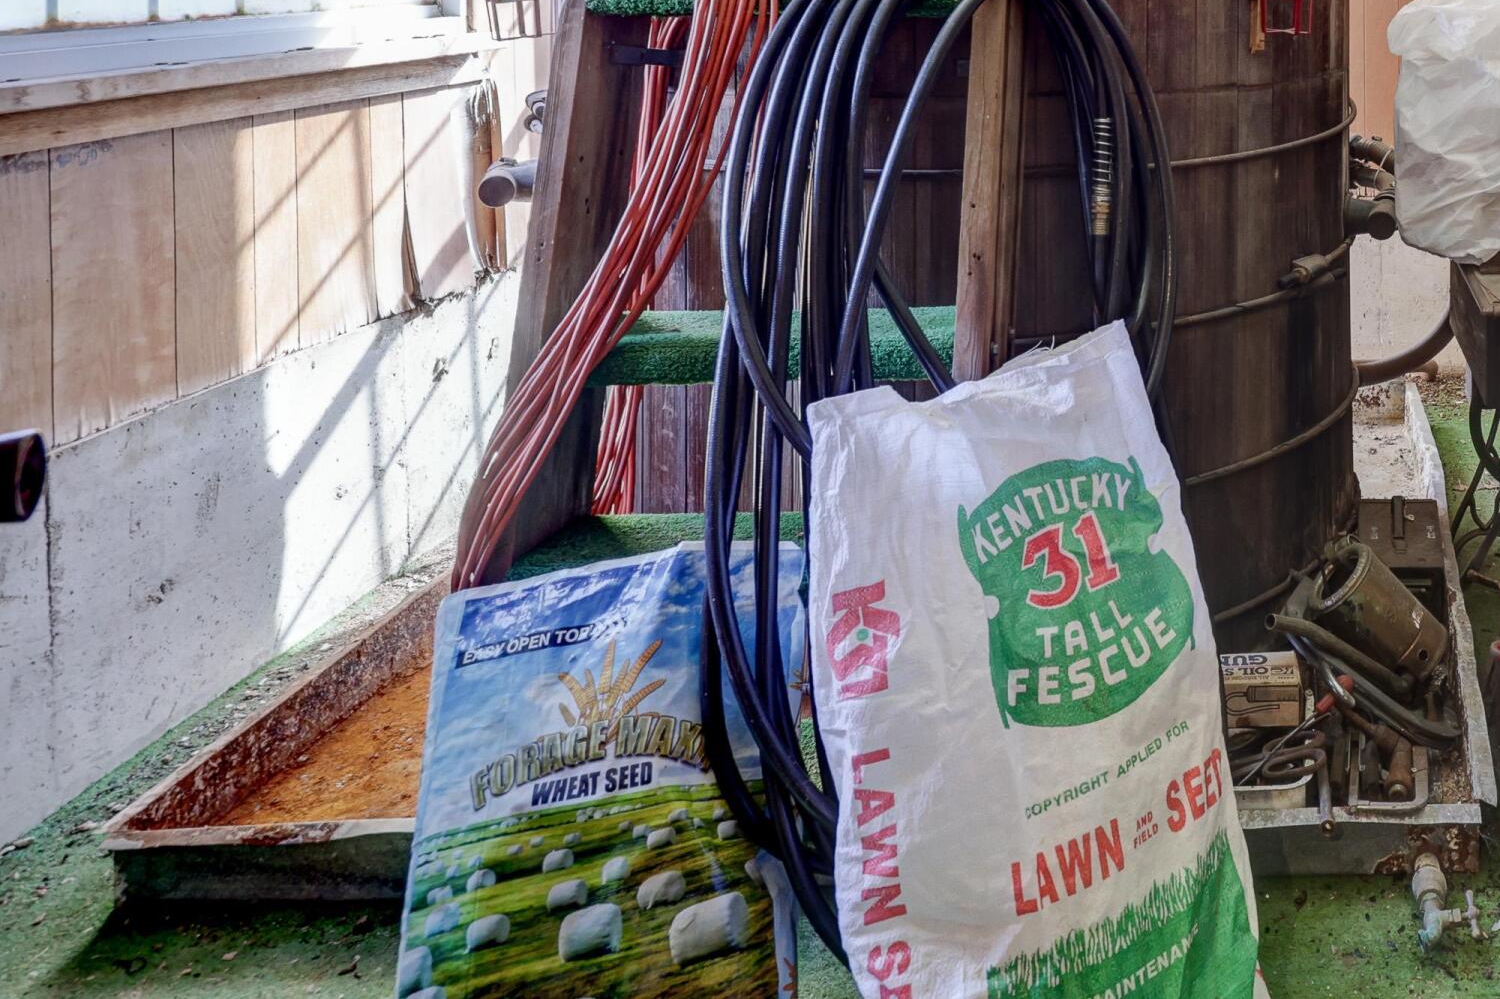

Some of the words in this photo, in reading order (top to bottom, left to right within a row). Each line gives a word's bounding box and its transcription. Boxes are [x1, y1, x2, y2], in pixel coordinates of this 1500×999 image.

[971, 472, 1131, 564] KENTUCKY
[1021, 510, 1121, 609] 31
[507, 632, 550, 654] OPEN
[1007, 607, 1176, 707] FESCUE
[1036, 600, 1132, 658] TALL
[1238, 666, 1269, 675] OIL
[470, 719, 609, 811] FORAGE
[531, 772, 600, 806] WHEAT
[605, 761, 653, 793] SEED
[1025, 771, 1109, 819] COPYRIGHT
[1117, 737, 1163, 778] APPLIED
[1165, 720, 1189, 742] FOR
[851, 748, 908, 927] LAWN
[1011, 818, 1125, 916] LAWN
[1136, 811, 1153, 832] AND
[1133, 823, 1158, 849] FIELD
